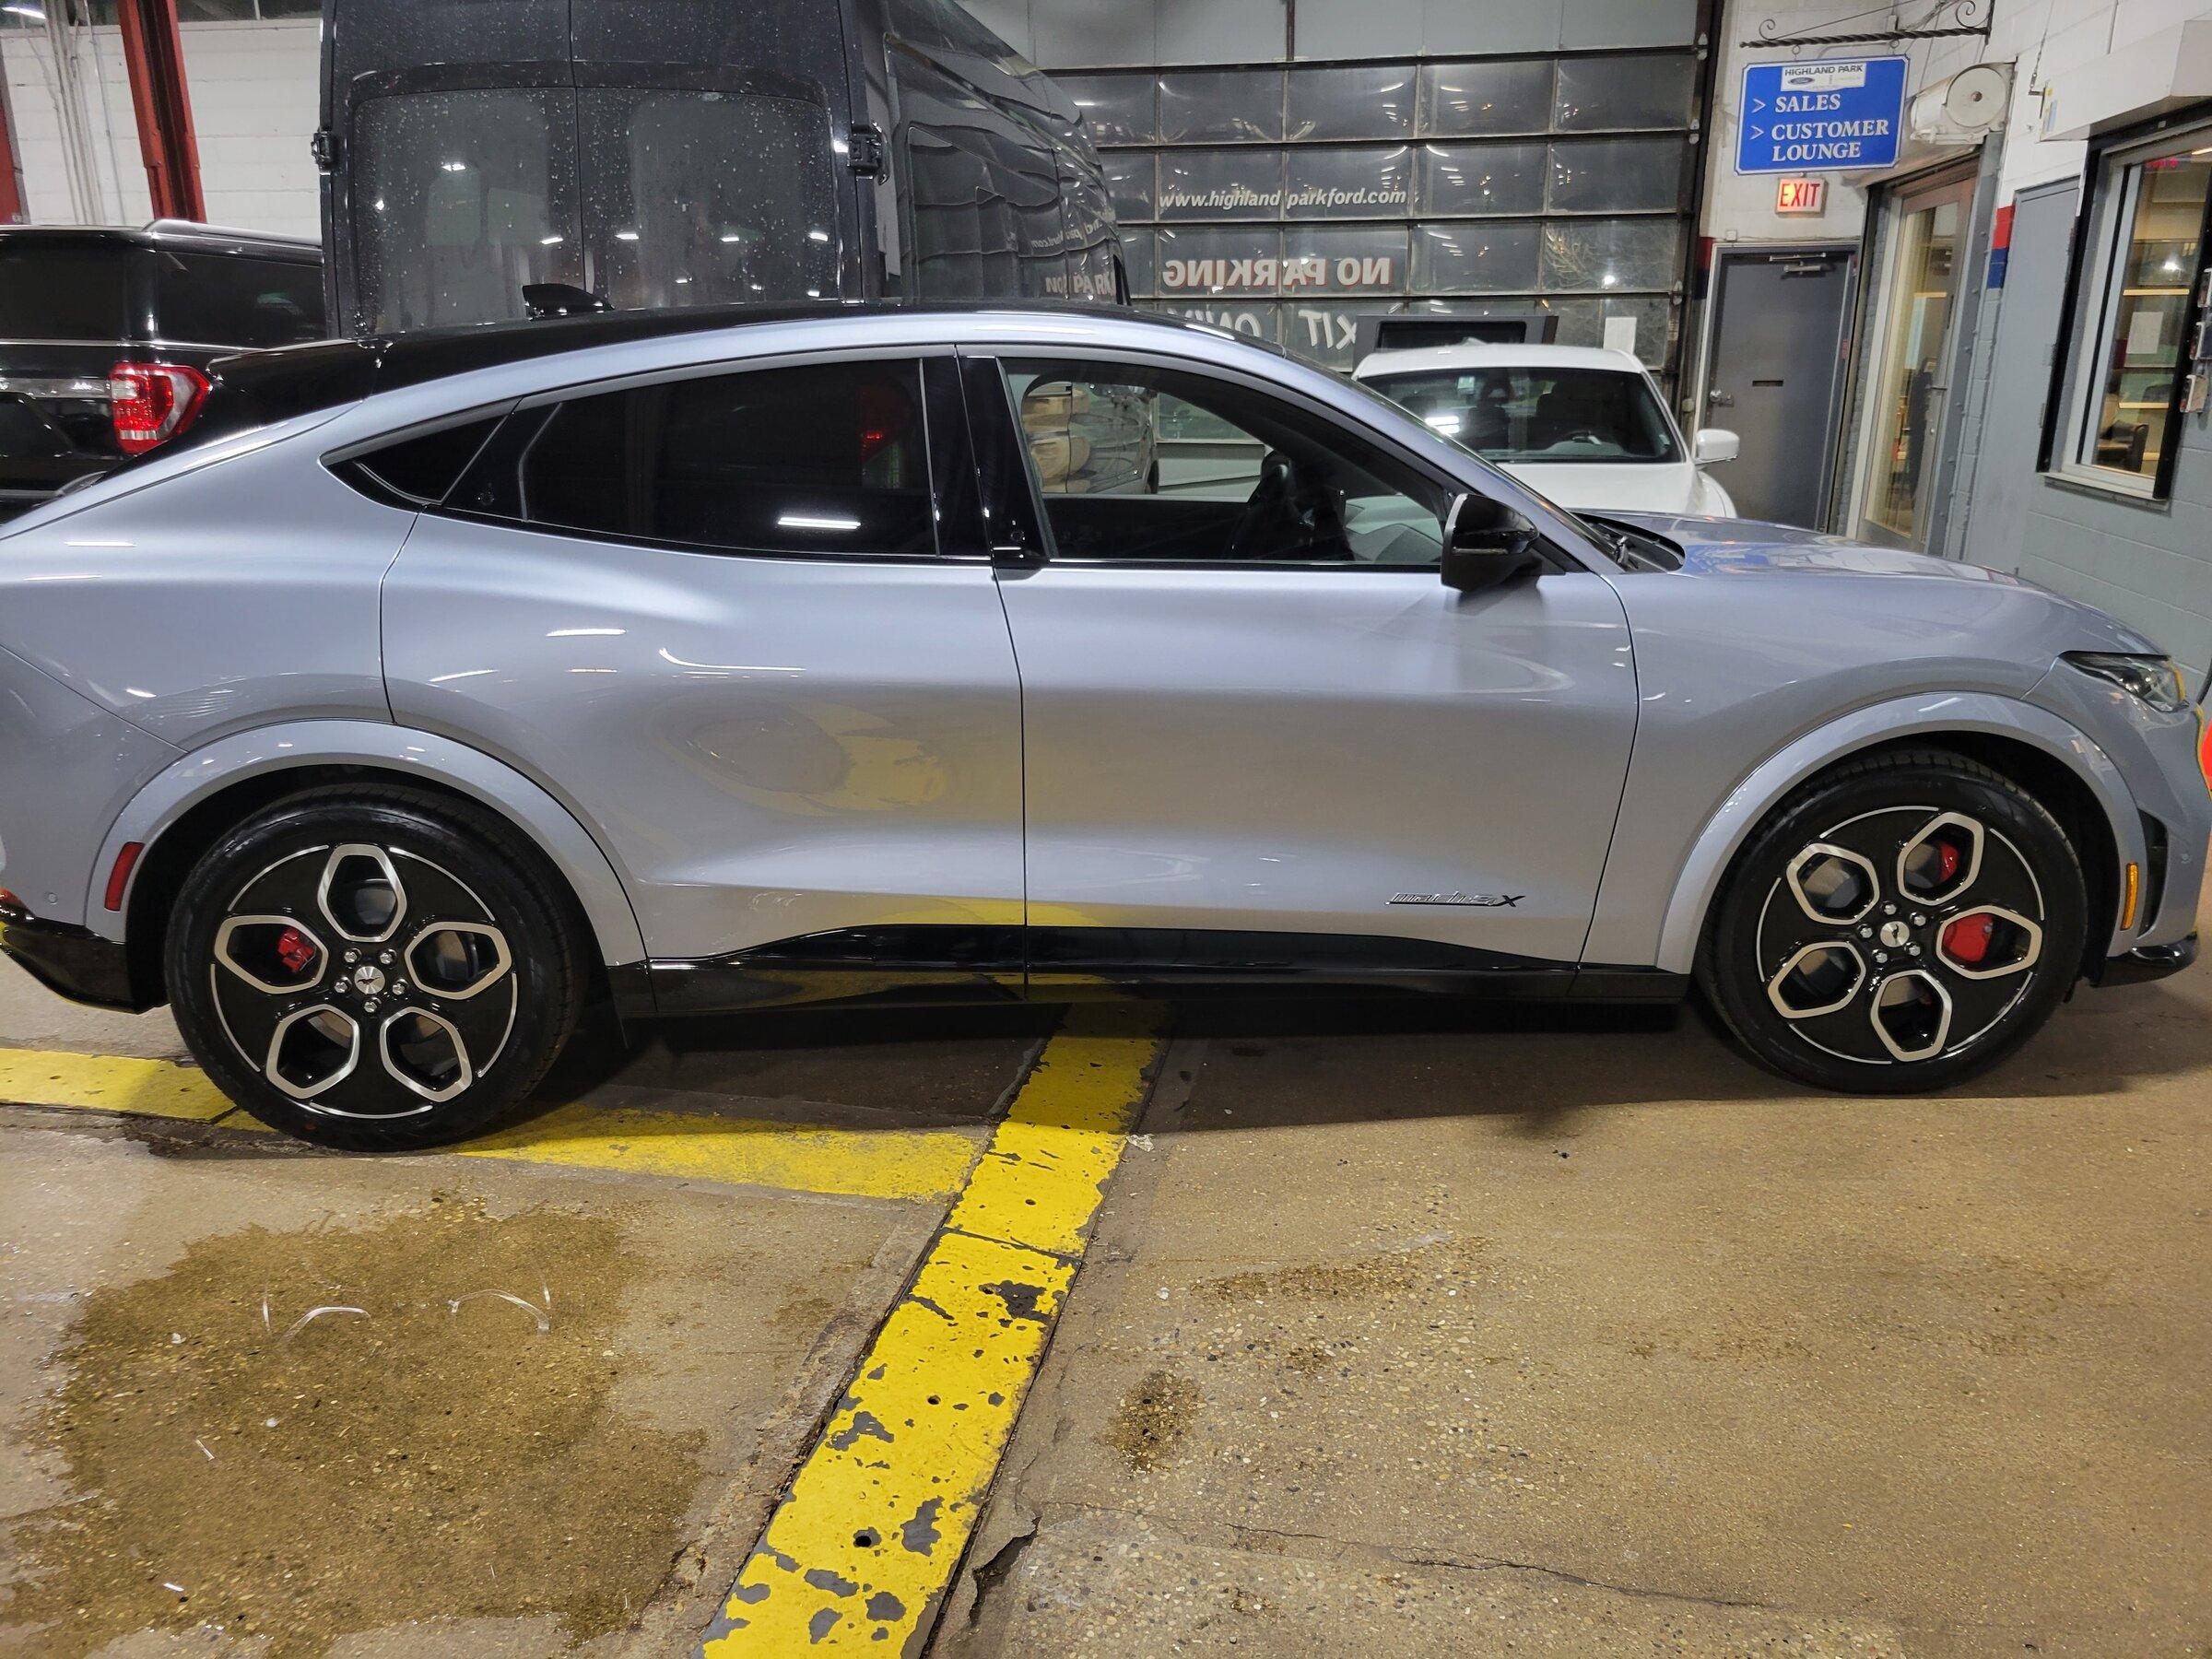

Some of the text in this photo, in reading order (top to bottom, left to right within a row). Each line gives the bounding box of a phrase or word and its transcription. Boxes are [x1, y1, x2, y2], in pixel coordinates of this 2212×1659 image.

[1784, 64, 1863, 76] HIGHLAND PARK
[1775, 93, 1841, 113] SALES
[1771, 119, 1889, 141] CUSTOMER
[1771, 142, 1861, 162] LOUNGE
[1779, 182, 1821, 207] EXIT
